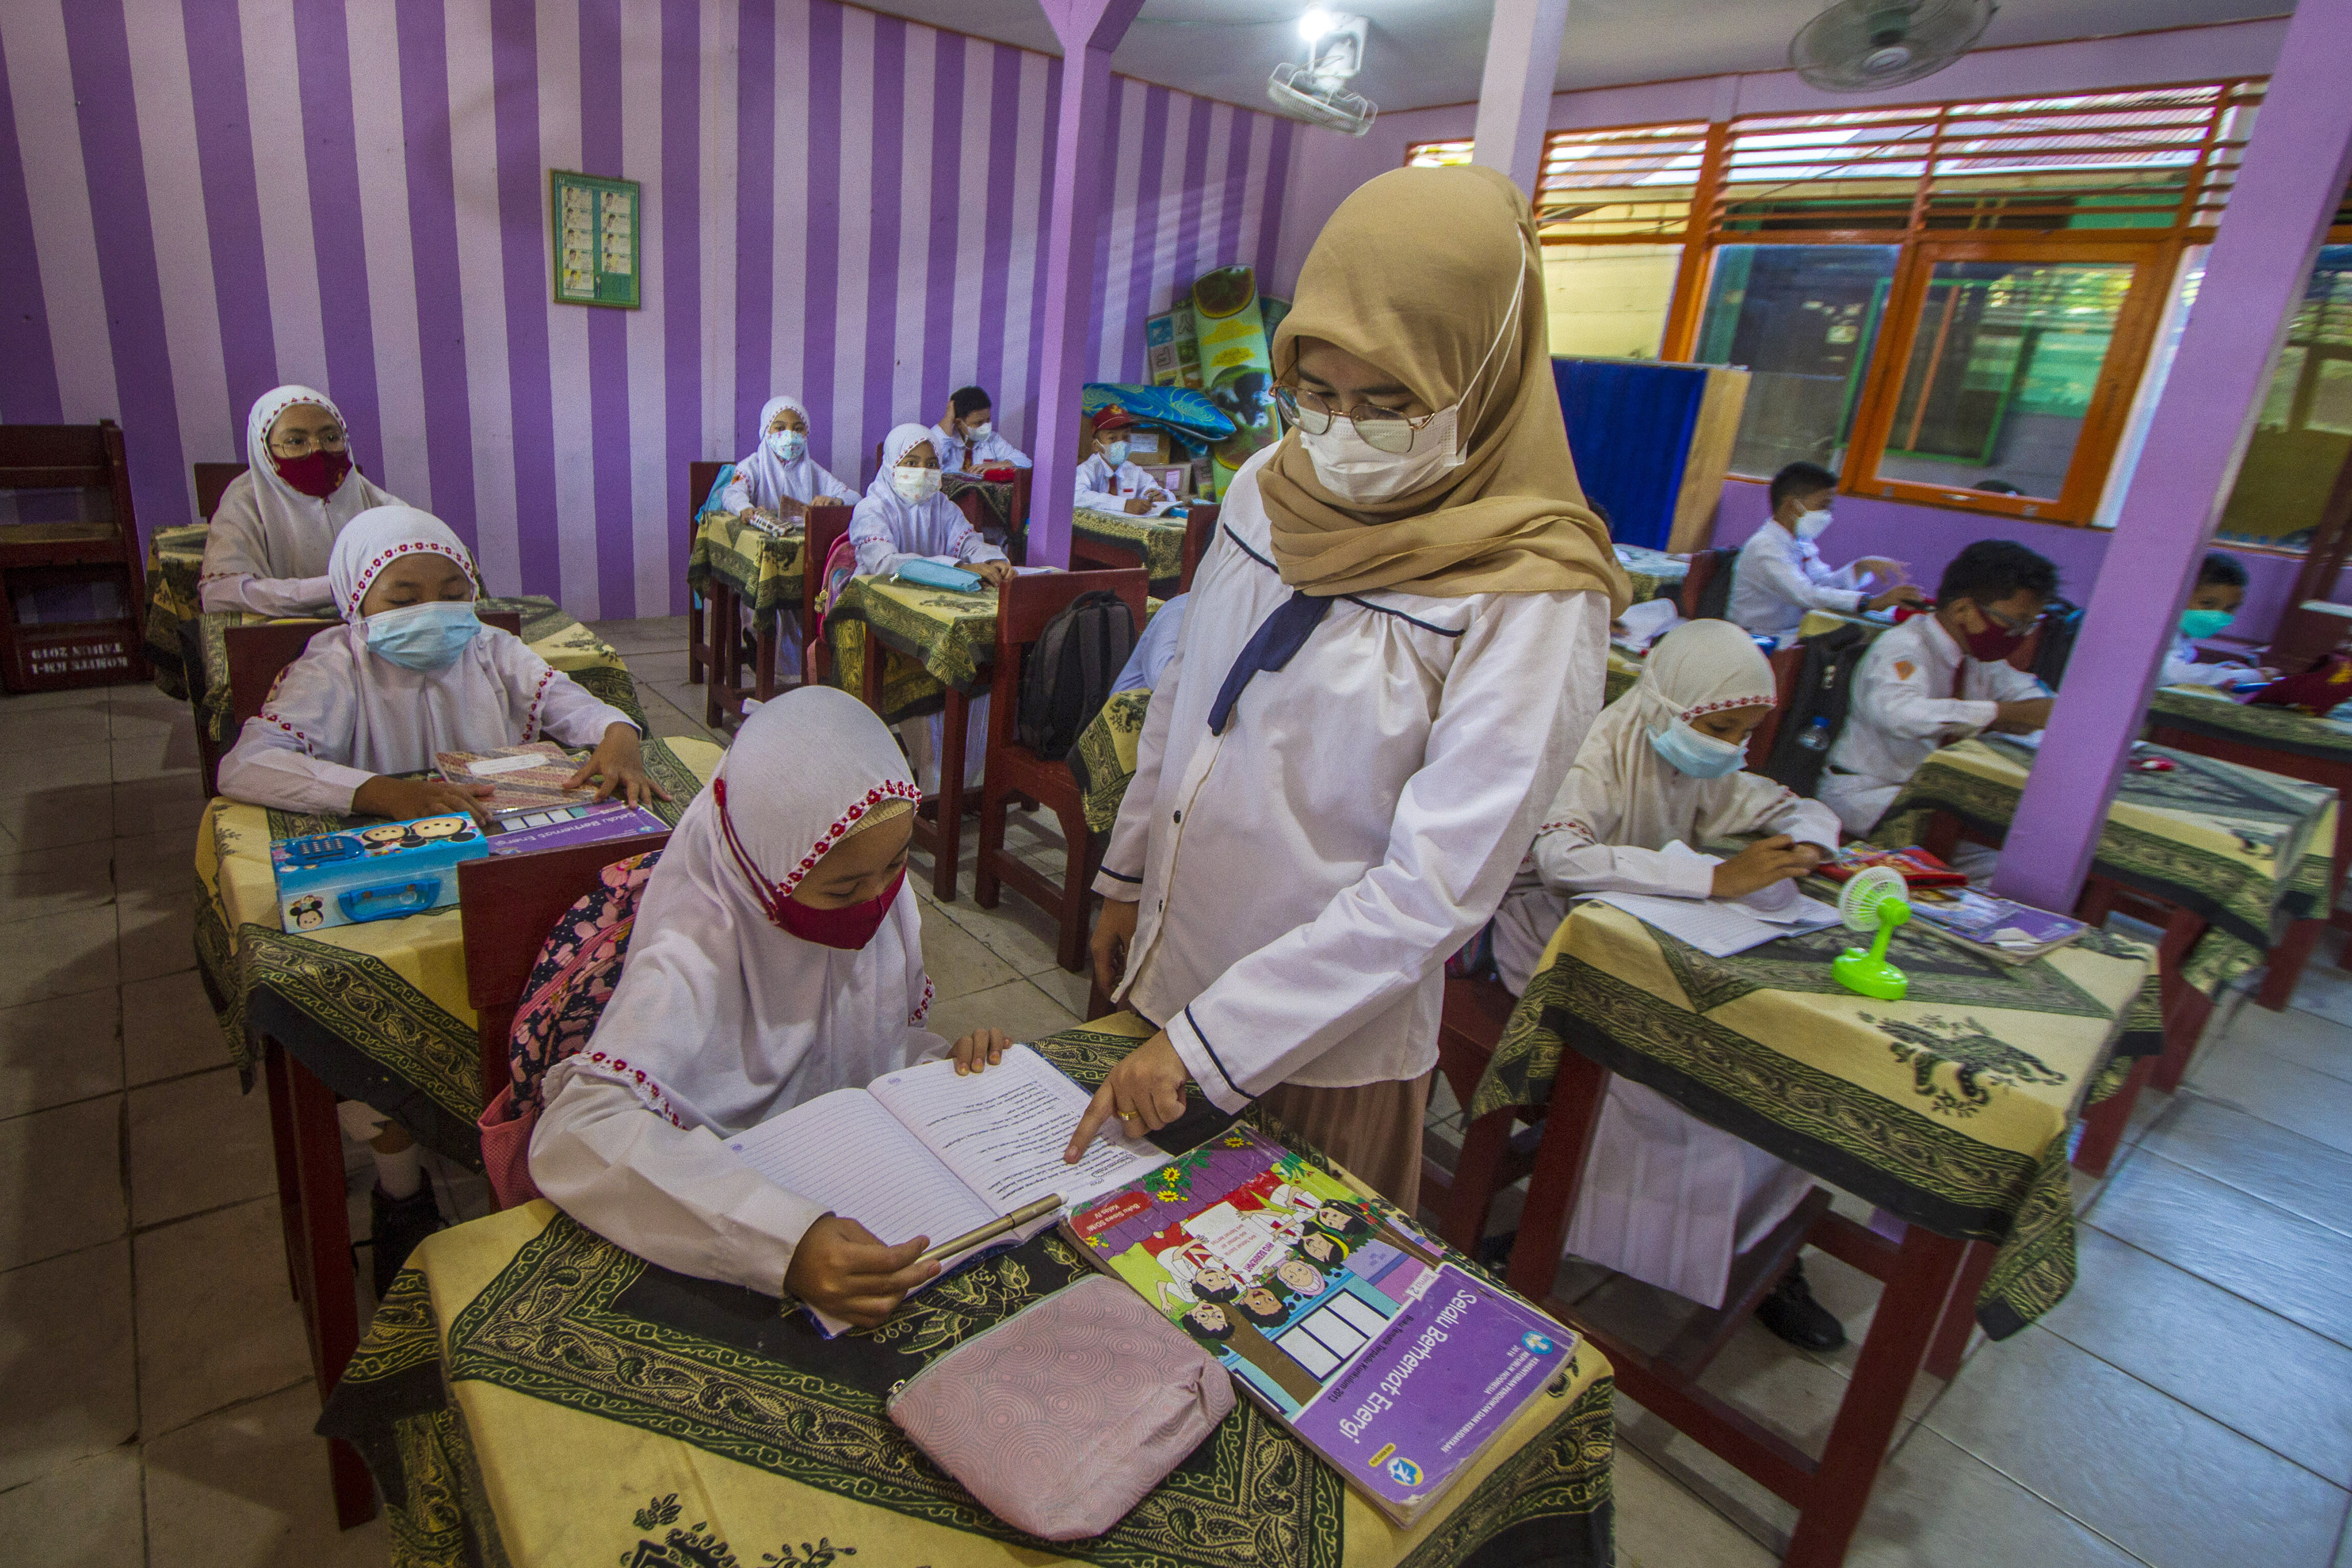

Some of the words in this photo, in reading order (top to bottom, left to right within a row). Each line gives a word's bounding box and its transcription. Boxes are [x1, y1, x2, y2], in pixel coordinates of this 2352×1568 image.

[72, 643, 122, 656] TAHUN
[537, 819, 600, 838] Berhemat
[494, 834, 536, 846] Energi
[1102, 1205, 1120, 1214] Kelas
[1105, 1211, 1124, 1222] Siswa
[1122, 1203, 1140, 1213] Buku
[1086, 1220, 1106, 1232] SD/MI
[1262, 1242, 1275, 1251] AYO
[1243, 1251, 1268, 1272] BERHEMAT
[1409, 1286, 1419, 1295] 2
[1414, 1273, 1435, 1289] Tema
[1434, 1289, 1477, 1329] Selalu
[1397, 1314, 1414, 1329] Buku
[1379, 1326, 1403, 1347] Tematik
[1362, 1343, 1386, 1365] Terpadu
[1378, 1325, 1448, 1397] Berhemat
[1506, 1350, 1531, 1373] REPUBLIK
[1338, 1362, 1368, 1390] Kurikulum
[1506, 1356, 1540, 1388] KEMENTERIAN
[1483, 1370, 1511, 1395] INDONESIA
[1327, 1387, 1344, 1403] 2013
[1480, 1385, 1511, 1414] PENDIDIKAN
[1338, 1389, 1392, 1444] Energi
[1470, 1410, 1485, 1424] DAN
[1439, 1420, 1475, 1453] KEBUDAYAAN
